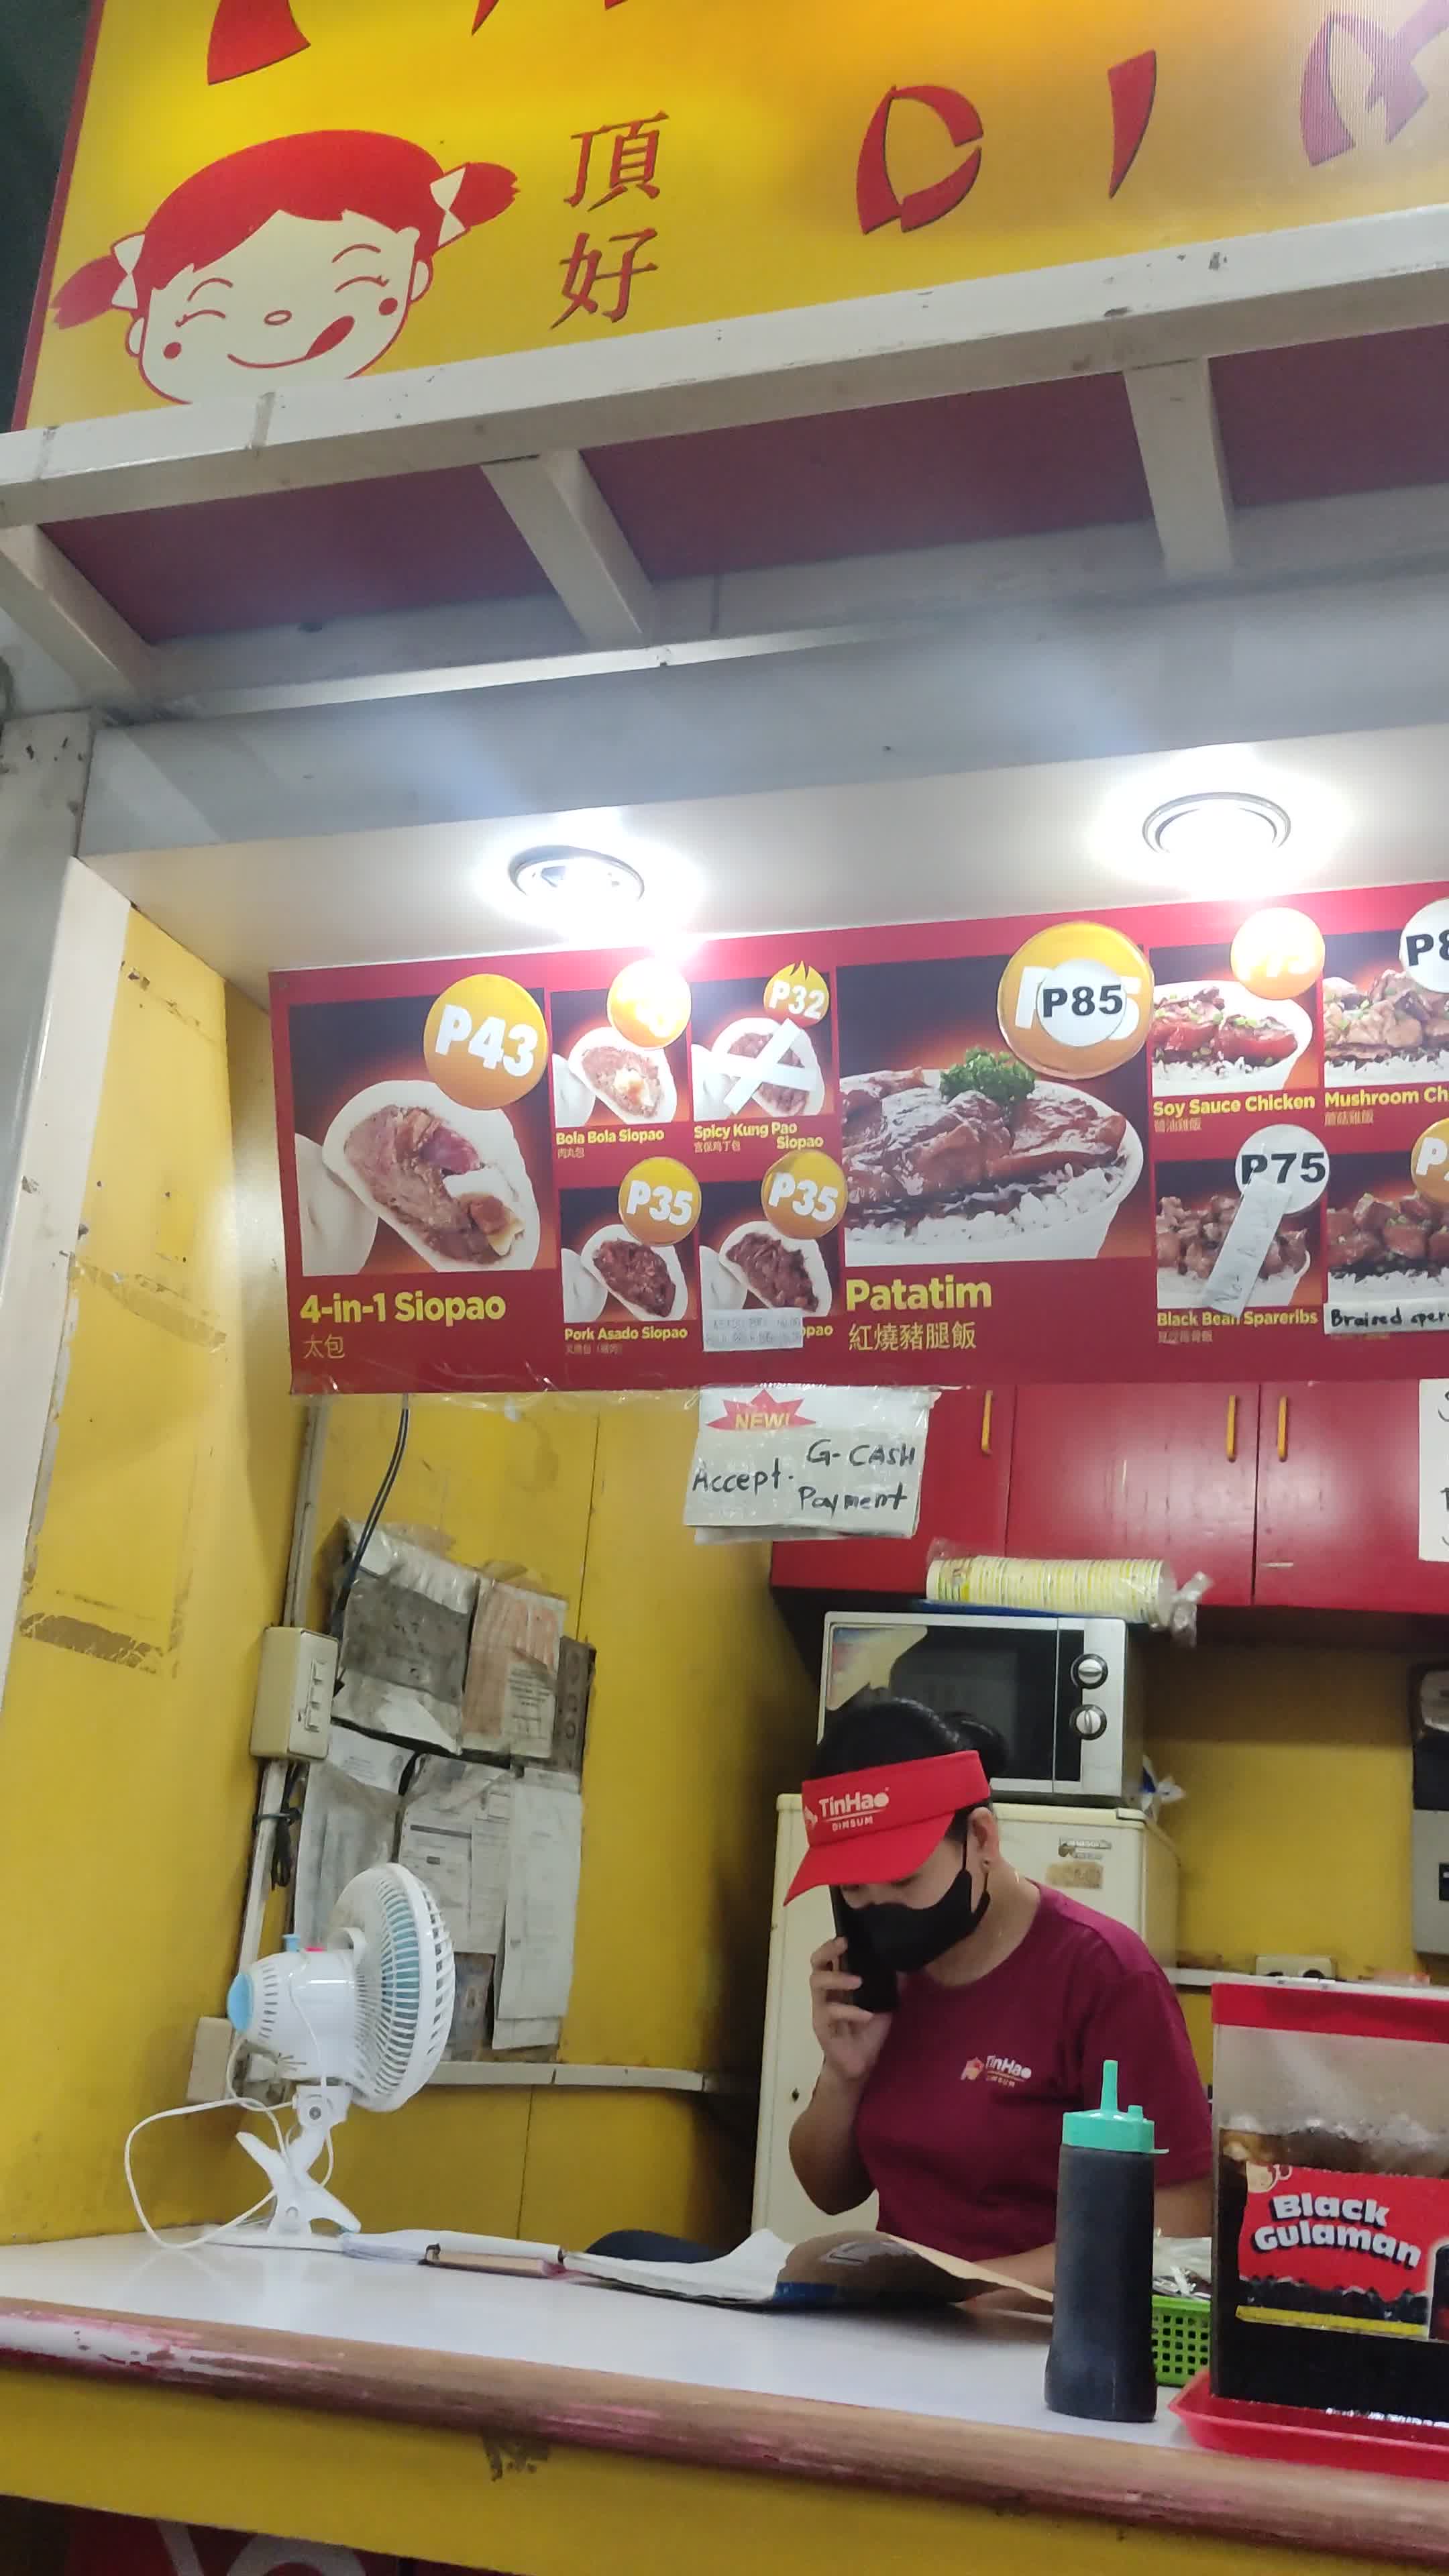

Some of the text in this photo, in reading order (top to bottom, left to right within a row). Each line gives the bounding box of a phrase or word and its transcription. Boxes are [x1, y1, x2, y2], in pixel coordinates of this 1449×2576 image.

[550, 111, 669, 329] 頂好
[769, 979, 825, 1020] P32
[1042, 984, 1123, 1018] P85
[435, 1003, 538, 1077] P43
[1152, 1093, 1316, 1118] Soy Sauce Chicken
[1324, 1088, 1419, 1108] Mushroom
[556, 1128, 665, 1146] Bola Bola Siopao
[694, 1121, 798, 1141] Spicy Kung Pao
[776, 1135, 824, 1150] Siopao
[1241, 1152, 1326, 1185] P75
[626, 1179, 693, 1226] P35
[767, 1172, 839, 1222] P35
[300, 1289, 506, 1327] 4-in-1 Siopao
[846, 1274, 992, 1311] Patatim
[564, 1326, 688, 1342] Pork Asado Siopao
[1157, 1310, 1198, 1326] Black
[1243, 1309, 1319, 1328] Spareribs
[303, 1334, 345, 1359] 太包
[848, 1320, 977, 1351] 紅燒豬腿飯
[735, 1411, 791, 1430] NEW!
[798, 1482, 908, 1519] Payment
[818, 1791, 890, 1817] TinHao
[985, 2053, 1032, 2080] TinHao
[1271, 2192, 1391, 2228] Black
[1252, 2219, 1422, 2269] Gulaman
